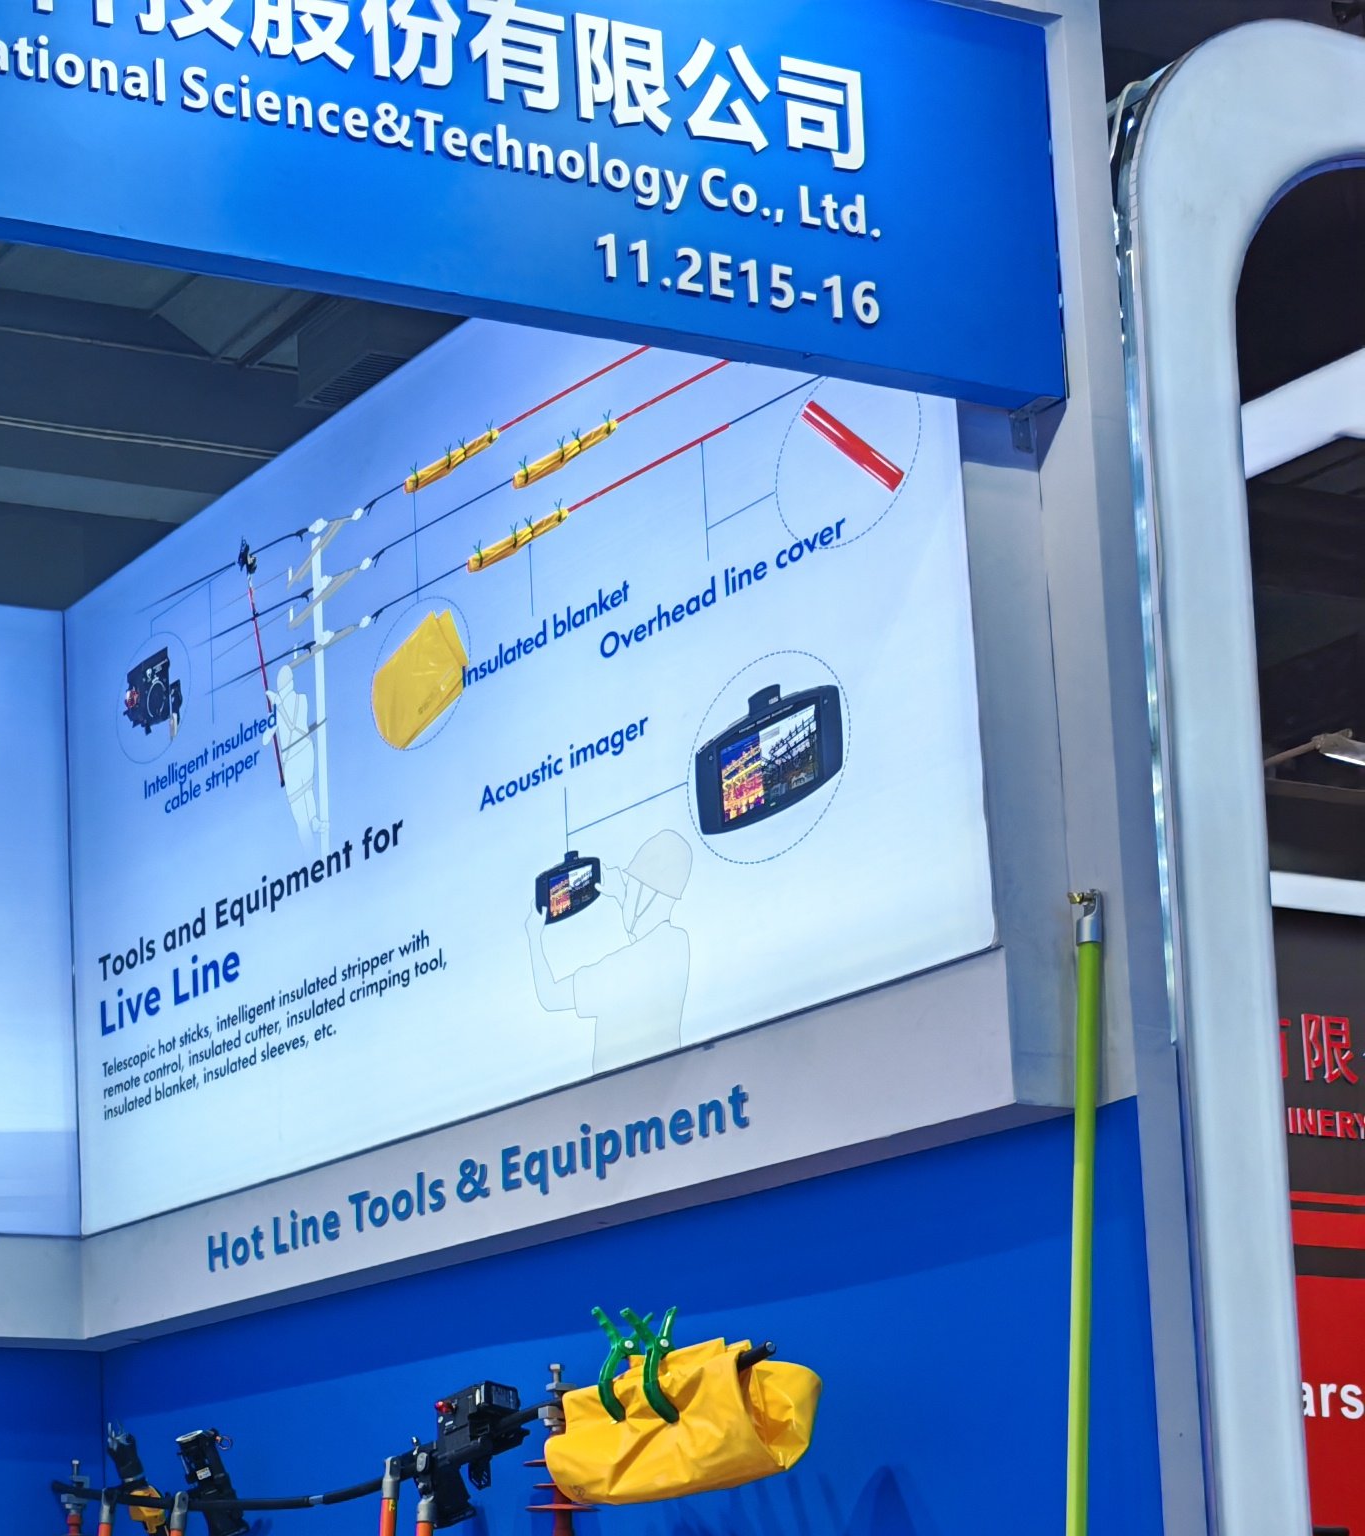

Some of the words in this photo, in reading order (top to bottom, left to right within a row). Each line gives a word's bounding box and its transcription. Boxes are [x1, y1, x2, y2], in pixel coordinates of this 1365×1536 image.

[33, 0, 867, 171] 股份有限公司
[181, 67, 690, 211] Science&Technology
[701, 167, 784, 224] Co.,
[799, 185, 882, 239] Ltd.
[596, 234, 880, 326] 11.2E15-16
[461, 619, 548, 689] Insulated
[553, 579, 630, 638] blanket
[599, 576, 717, 659] Overhead
[724, 560, 768, 598] line
[775, 518, 846, 570] cover
[144, 747, 209, 800] Intelligent
[211, 703, 278, 762] insulated
[164, 779, 202, 814] cable
[205, 750, 261, 792] stripper
[479, 754, 564, 812] Acoustic
[568, 716, 649, 770] imager
[98, 937, 156, 982] Tools
[162, 907, 206, 953] and
[214, 840, 353, 930] Equipment
[361, 819, 404, 861] for
[99, 984, 162, 1036] Live
[172, 951, 241, 1006] Line
[102, 1043, 156, 1078] Telescopic
[157, 1035, 177, 1057] hot
[179, 1022, 213, 1048] sticks,
[216, 996, 276, 1033] intelligent
[278, 966, 337, 1007] insulated
[341, 948, 395, 983] stripper
[398, 929, 430, 958] with
[103, 1073, 141, 1100] remote
[143, 1058, 185, 1085] control,
[188, 1033, 242, 1067] insulated
[244, 1016, 282, 1045] cutter,
[286, 989, 346, 1028] insulated
[349, 966, 411, 1004] crimping
[414, 948, 448, 978] tool,
[103, 1090, 152, 1121] insulated
[154, 1074, 201, 1102] blanket,
[203, 1051, 257, 1085] insulated
[260, 1033, 309, 1063] sleeves,
[313, 1022, 338, 1042] etc.
[206, 1230, 265, 1273] Hot
[273, 1210, 341, 1254] Line
[348, 1170, 448, 1233] Tools
[456, 1157, 492, 1199] &
[501, 1084, 751, 1193] Equipment
